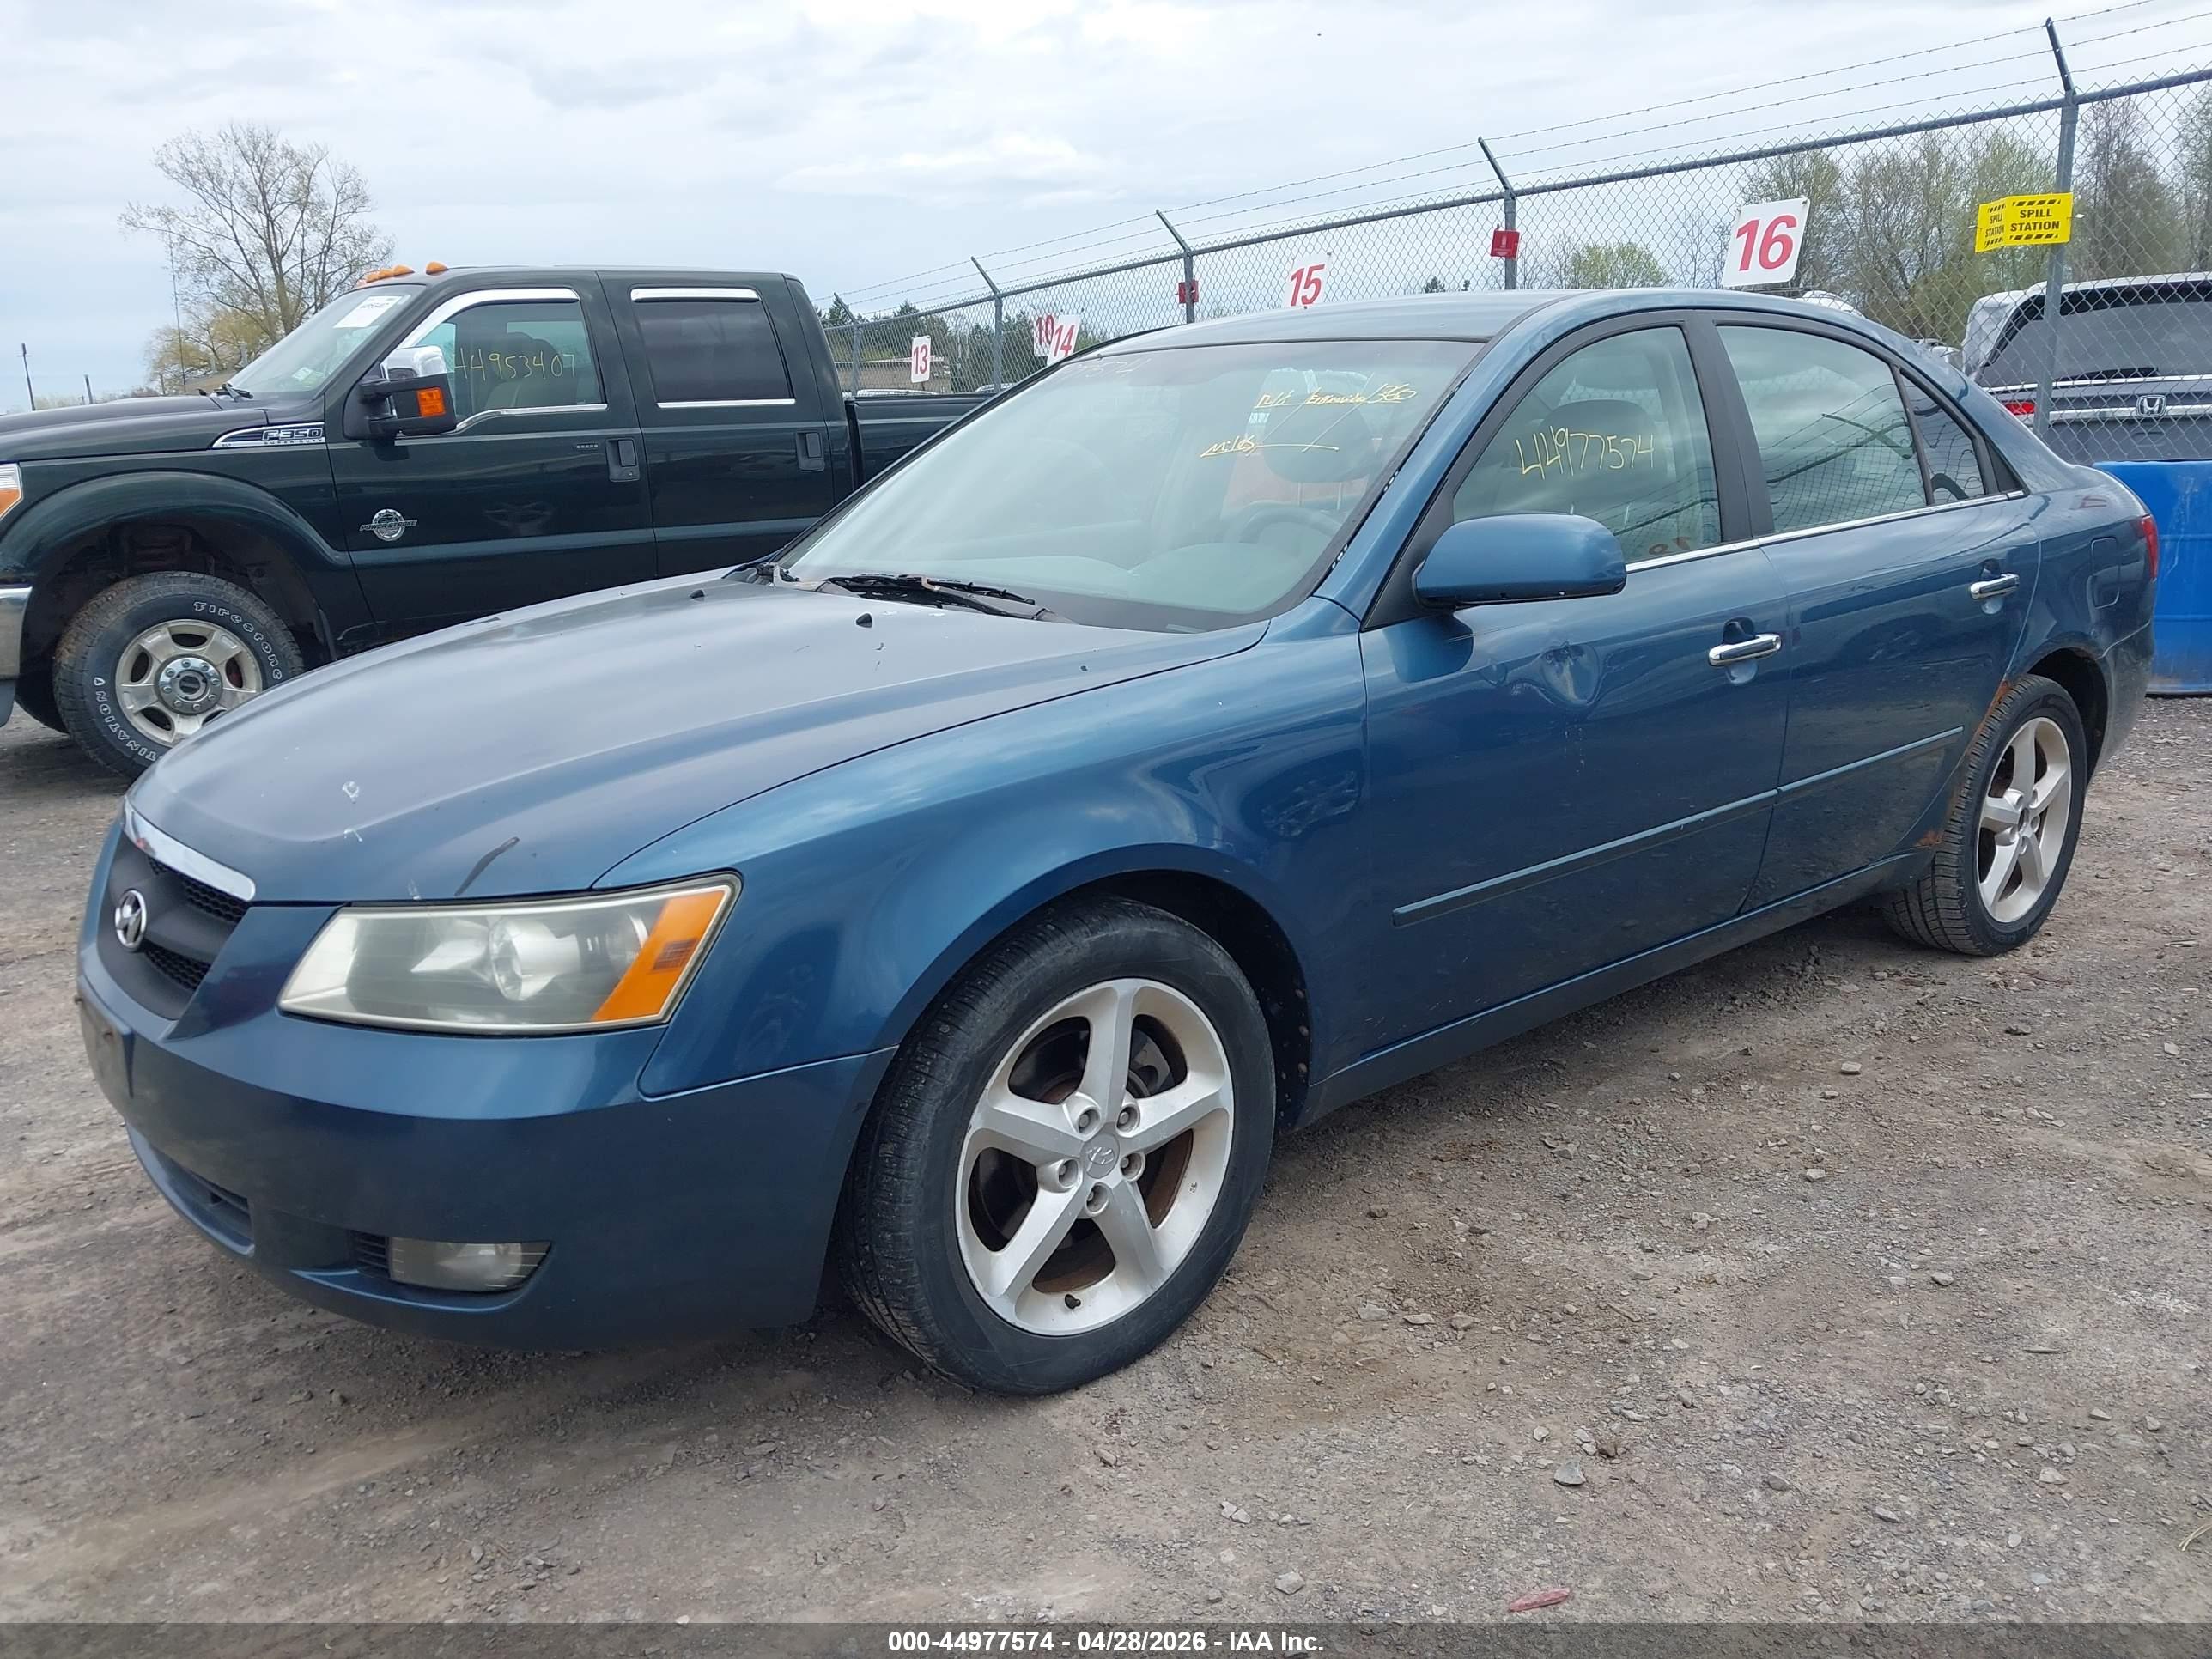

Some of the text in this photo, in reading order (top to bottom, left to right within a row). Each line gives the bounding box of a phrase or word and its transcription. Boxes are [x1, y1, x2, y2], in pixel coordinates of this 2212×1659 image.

[1990, 213, 2003, 224] SPILL
[2010, 221, 2060, 232] STATION
[2019, 209, 2052, 218] SPILL
[1735, 214, 1797, 271] 16
[1290, 264, 1326, 307] 15
[1036, 314, 1055, 346] 10
[1054, 325, 1075, 357] 14
[914, 344, 928, 374] 13
[1516, 425, 1655, 479] 44977574
[192, 601, 283, 680] Firestone
[94, 690, 158, 762] TINATION
